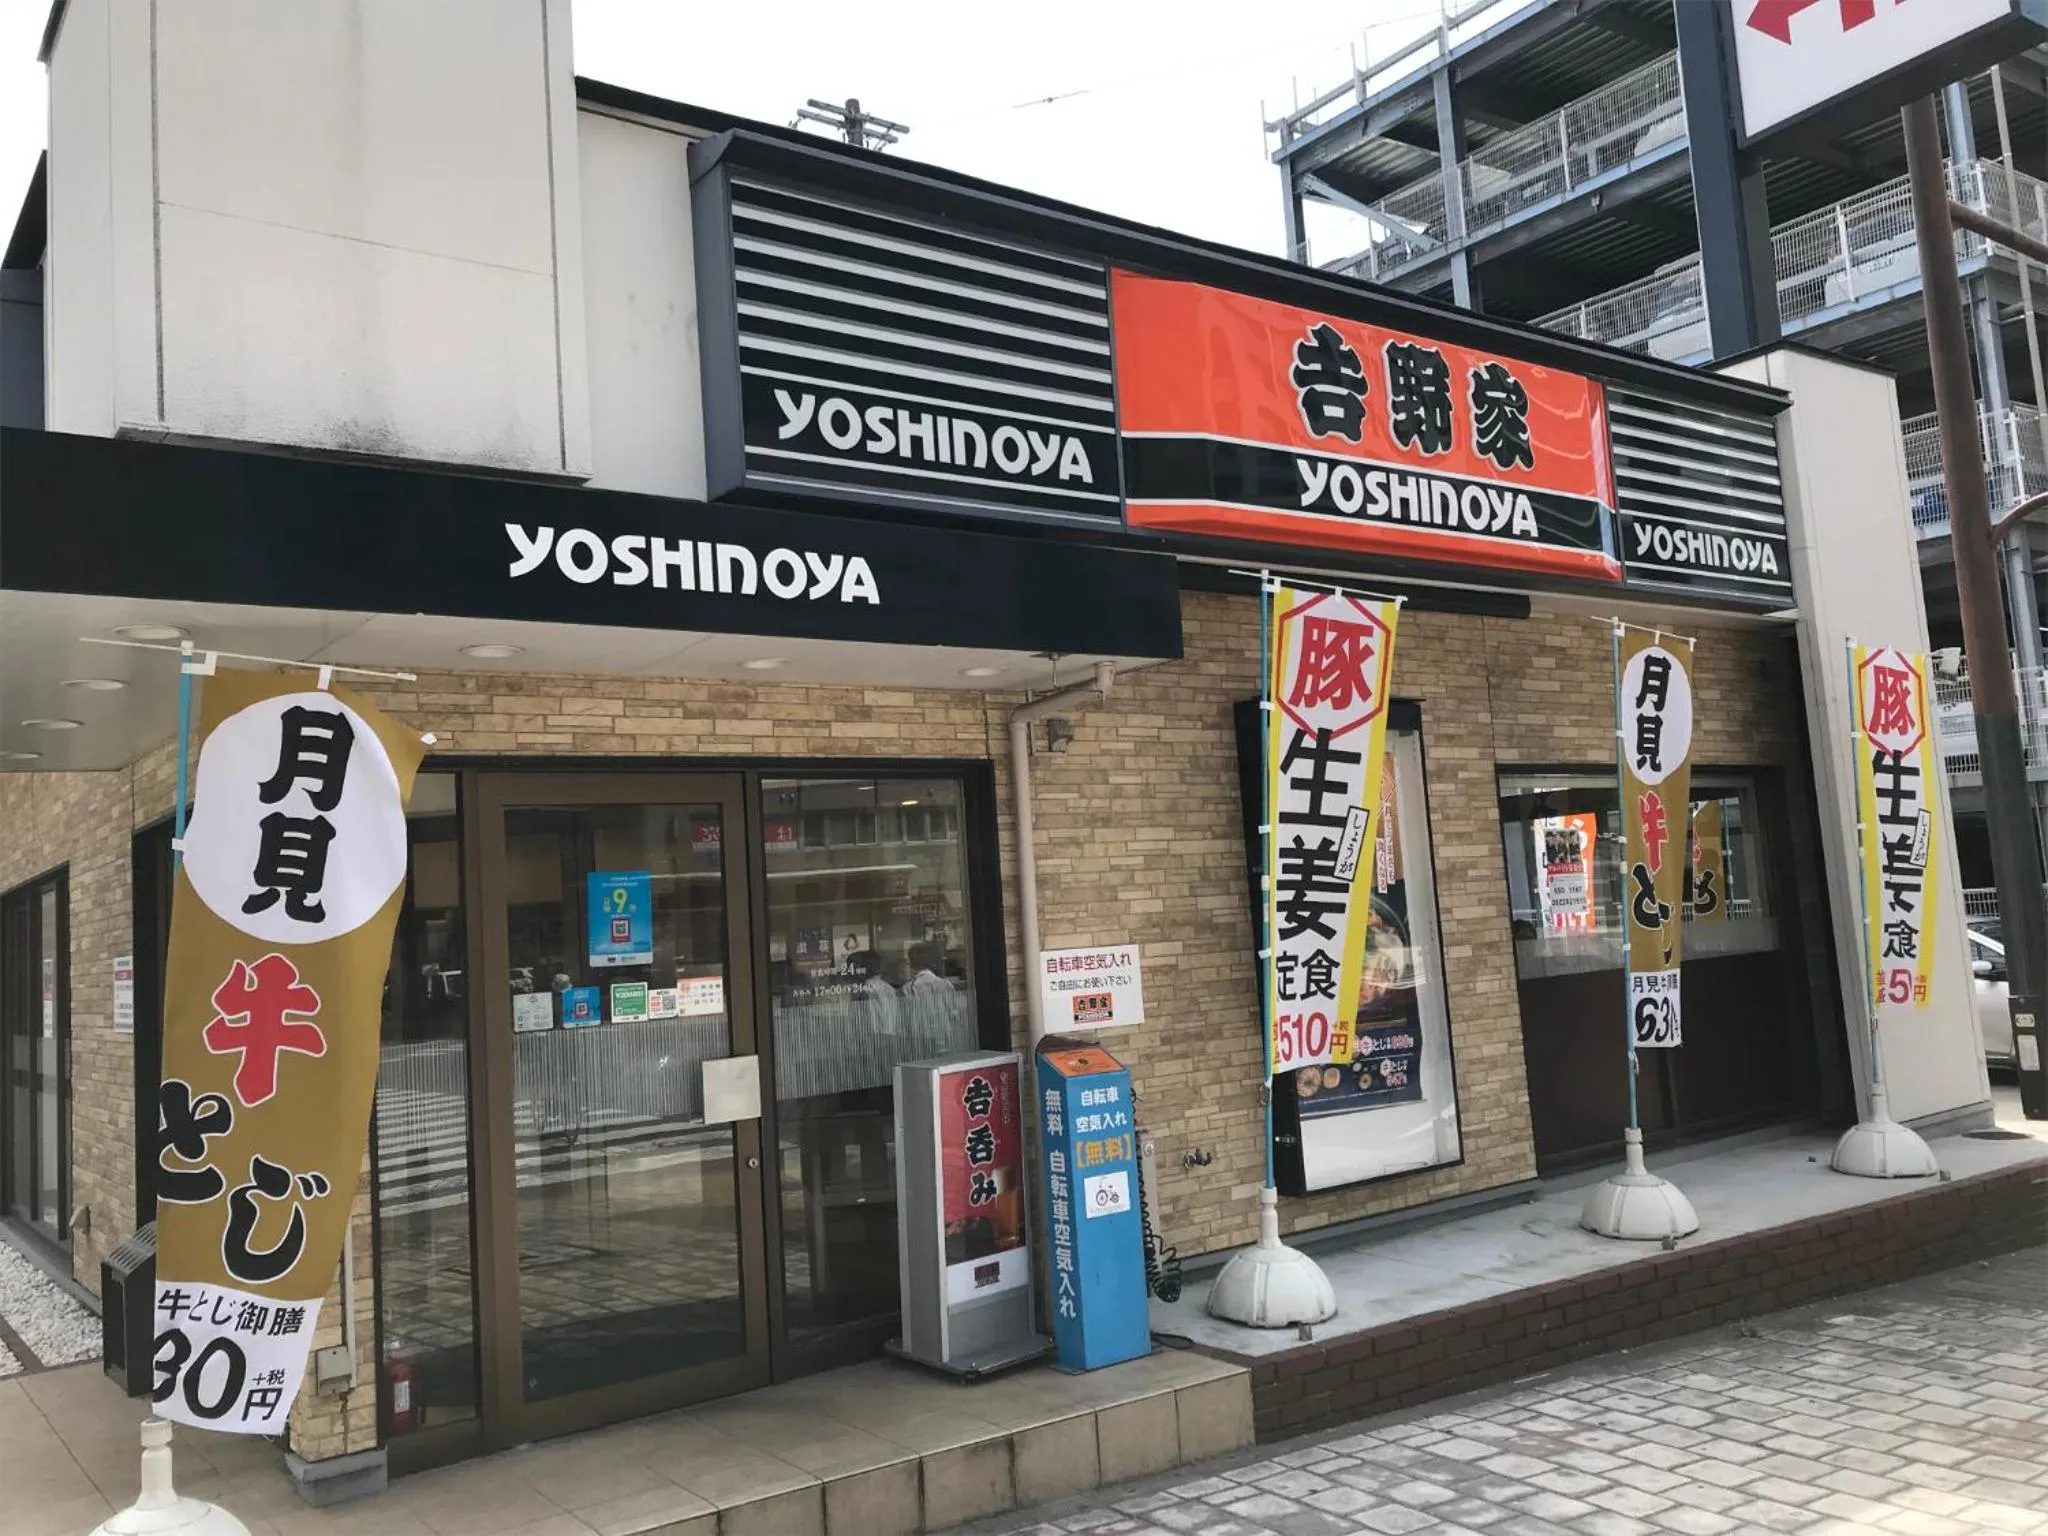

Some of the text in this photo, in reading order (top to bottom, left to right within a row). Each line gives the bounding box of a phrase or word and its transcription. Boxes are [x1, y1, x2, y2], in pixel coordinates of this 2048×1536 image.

[773, 388, 1094, 483] YOSHINOYA
[1296, 459, 1539, 537] YOSHINOYA
[505, 523, 880, 604] YOSHINOYA
[1633, 522, 1778, 574] YOSHINOYA
[1288, 615, 1375, 710] 豚
[1636, 654, 1671, 772] 月見
[1869, 665, 1915, 736] 豚
[242, 705, 356, 924] 月見
[1338, 813, 1364, 874] しょうが
[1046, 953, 1132, 974] 自転車空気入れ
[1075, 1112, 1127, 1133] 空気入れ
[1081, 1086, 1119, 1106] 自転車
[1045, 1089, 1076, 1318] 無料 自転車空気入れ
[157, 1289, 305, 1337] 牛とじ御膳
[241, 1388, 283, 1421] 円
